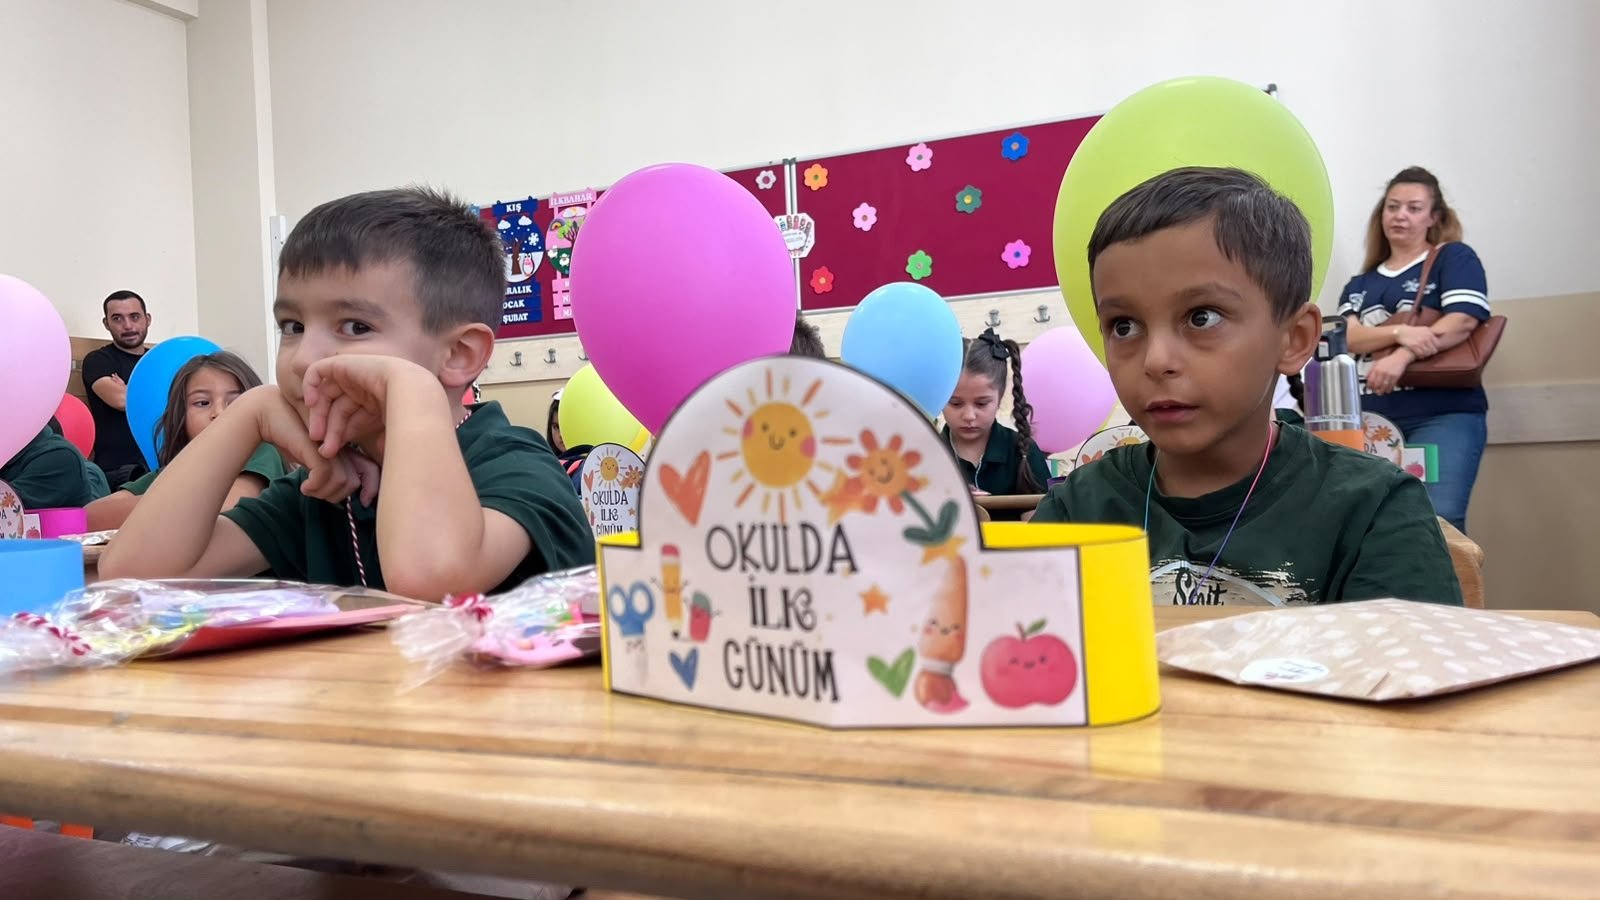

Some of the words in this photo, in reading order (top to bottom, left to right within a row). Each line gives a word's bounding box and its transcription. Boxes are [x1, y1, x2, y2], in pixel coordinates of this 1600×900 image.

[506, 203, 522, 213] KIŞ
[505, 285, 532, 295] RALIK
[502, 312, 528, 324] ŞUBAT
[592, 490, 628, 506] OKULDA
[601, 505, 618, 521] İLK
[705, 521, 859, 575] OKULDA
[748, 575, 817, 632] İLK
[723, 636, 841, 703] GÜNÜM
